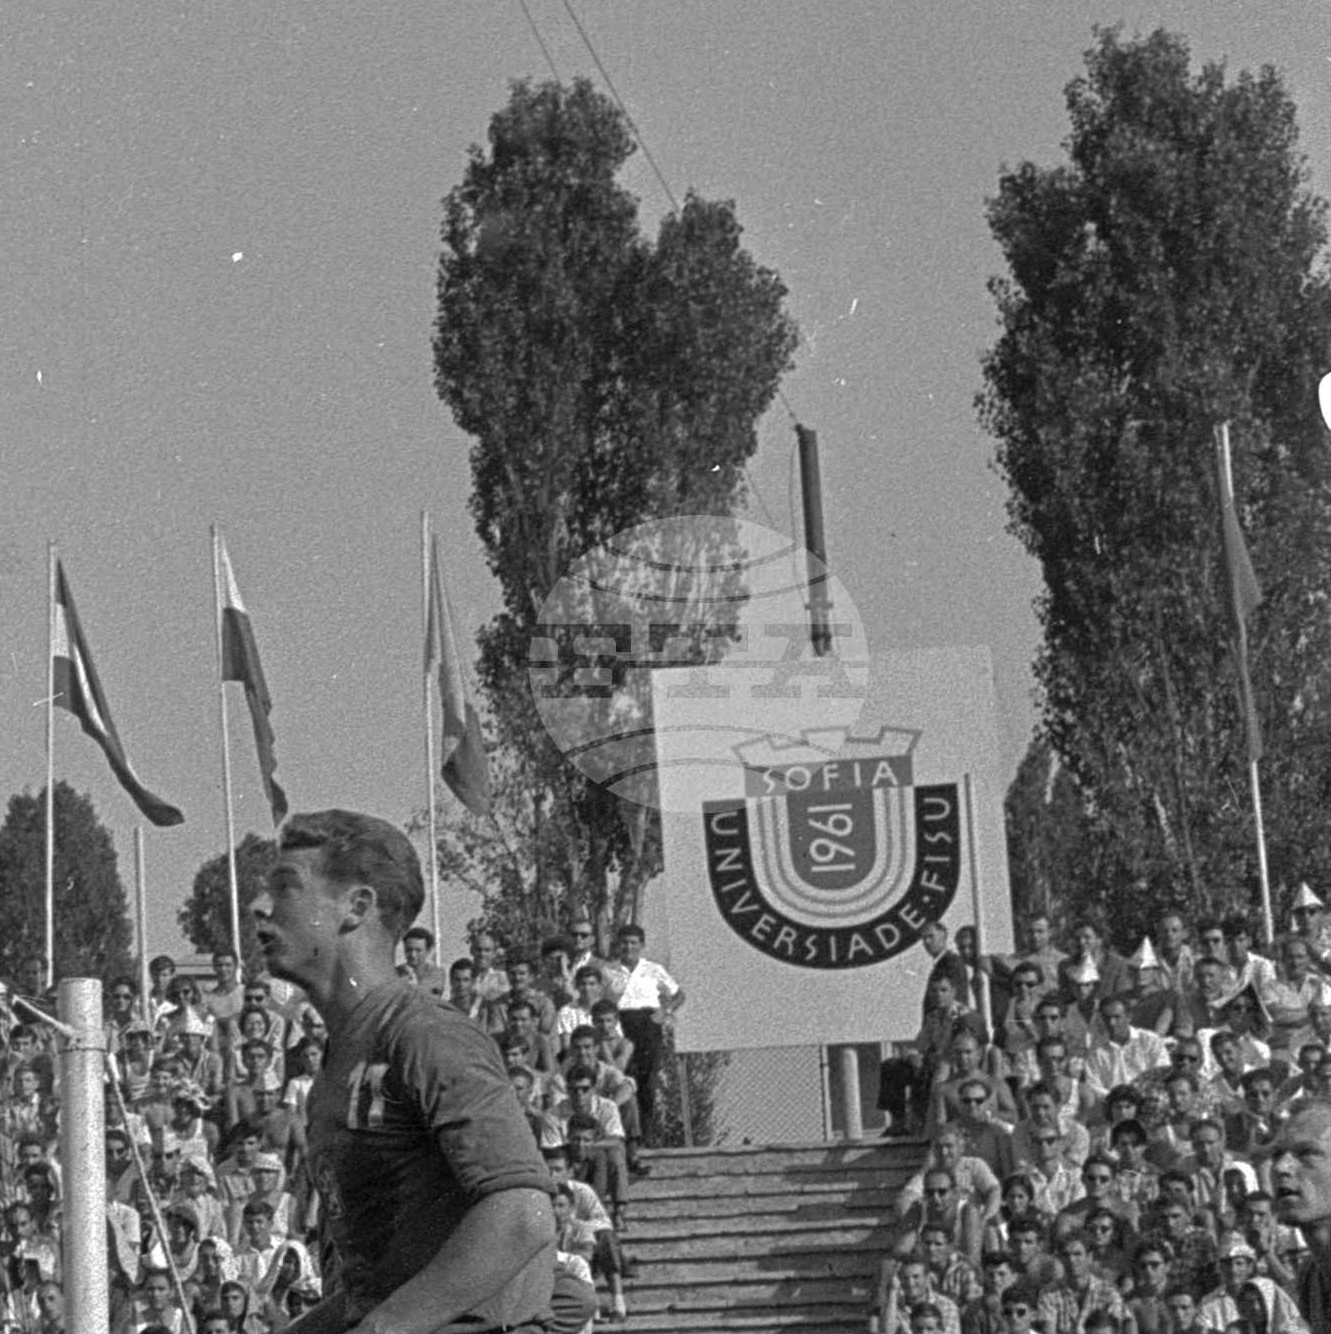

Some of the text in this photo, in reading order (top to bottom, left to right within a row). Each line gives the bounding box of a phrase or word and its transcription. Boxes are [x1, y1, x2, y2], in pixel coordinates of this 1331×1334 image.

[762, 760, 899, 794] SOFIA
[806, 803, 856, 873] 1961
[710, 796, 952, 962] UNIVERSIADE FISU
[347, 1061, 389, 1130] 11
